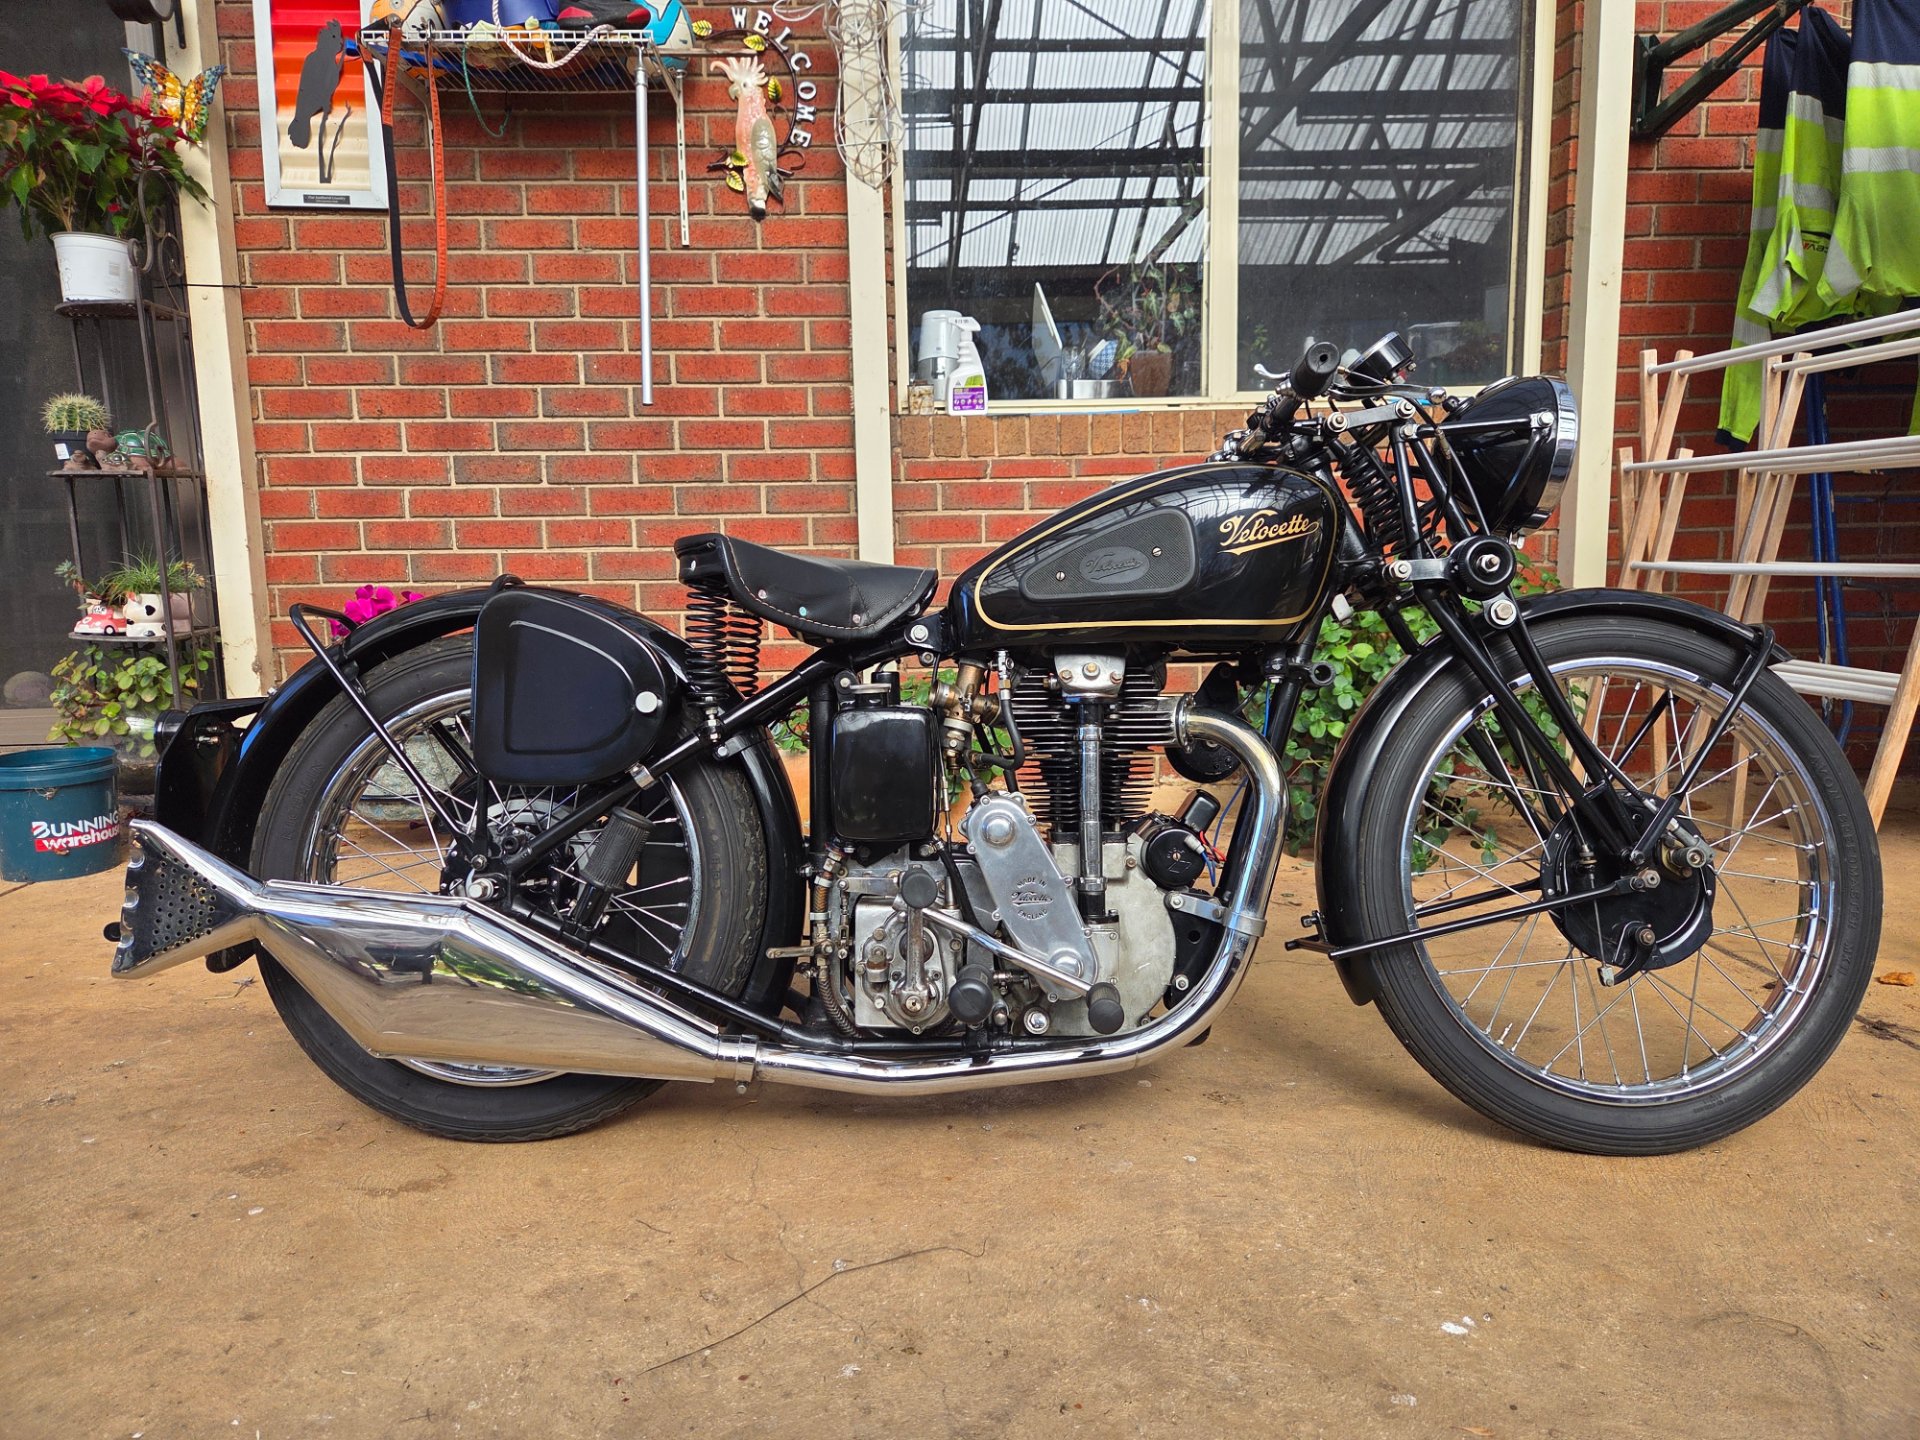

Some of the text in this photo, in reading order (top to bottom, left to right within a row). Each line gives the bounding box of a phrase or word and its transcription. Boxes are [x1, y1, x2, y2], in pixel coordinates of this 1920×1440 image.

[731, 6, 817, 147] WELCOME
[1219, 509, 1318, 551] Velocette
[31, 810, 119, 838] BUNNING
[42, 824, 120, 850] warehous
[1016, 876, 1036, 889] MADE
[1017, 909, 1048, 920] ENGLAND
